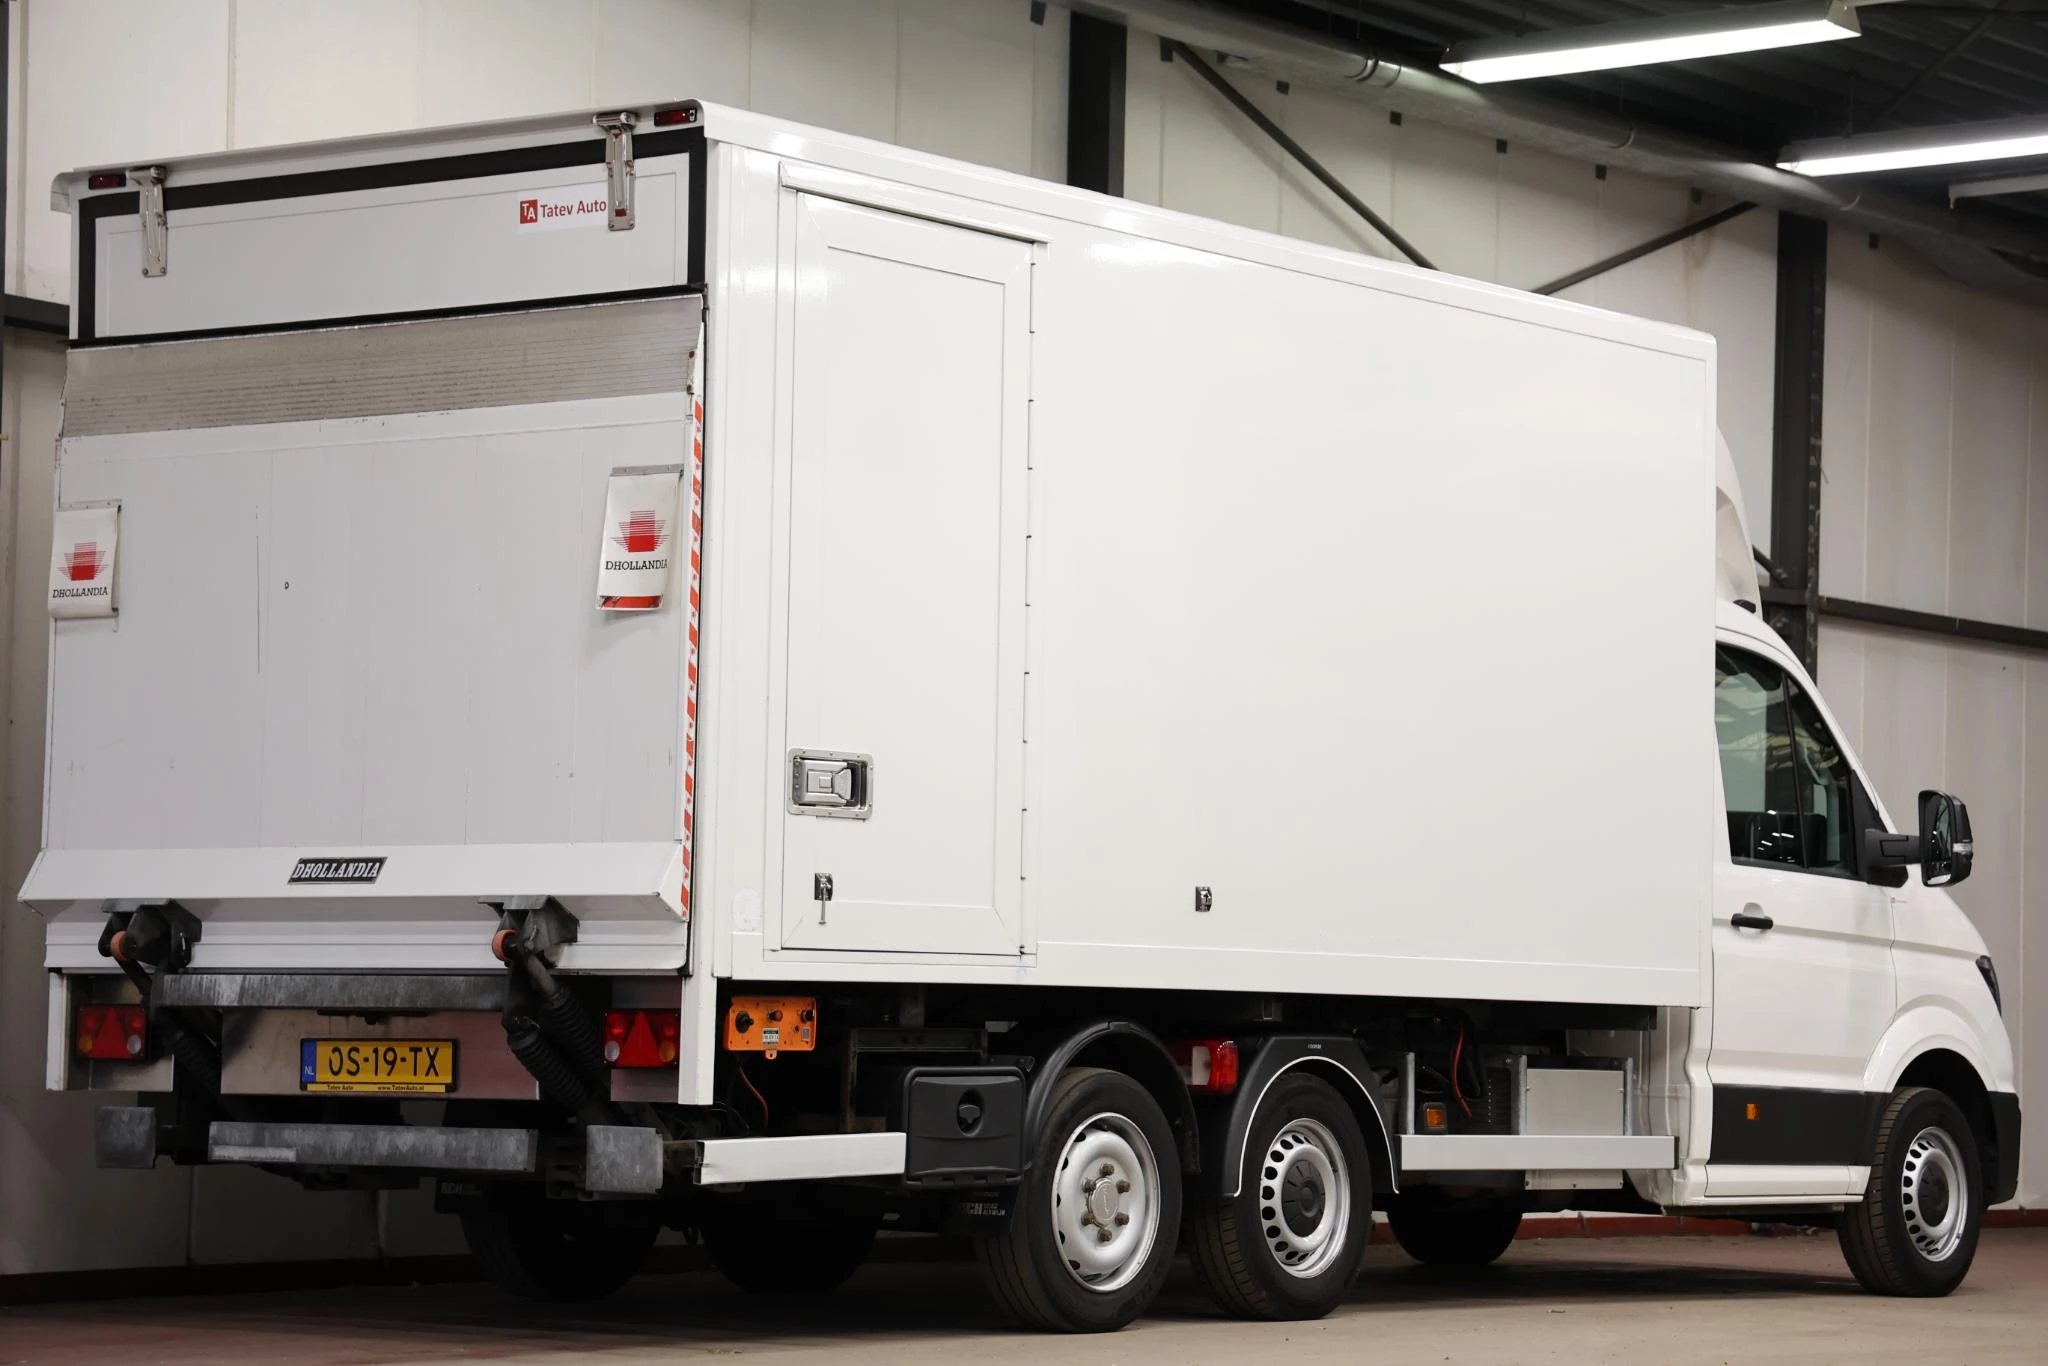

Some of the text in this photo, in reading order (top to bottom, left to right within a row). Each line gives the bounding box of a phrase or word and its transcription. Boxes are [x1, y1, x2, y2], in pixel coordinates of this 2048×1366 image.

[521, 199, 607, 221] TA Tatev Auto
[604, 559, 668, 571] DHOLLANDIA
[52, 586, 108, 599] DHOLLANDIA
[291, 862, 381, 878] DHOLLANDIA
[328, 1046, 440, 1077] OS-19-TX
[304, 1065, 315, 1075] NL
